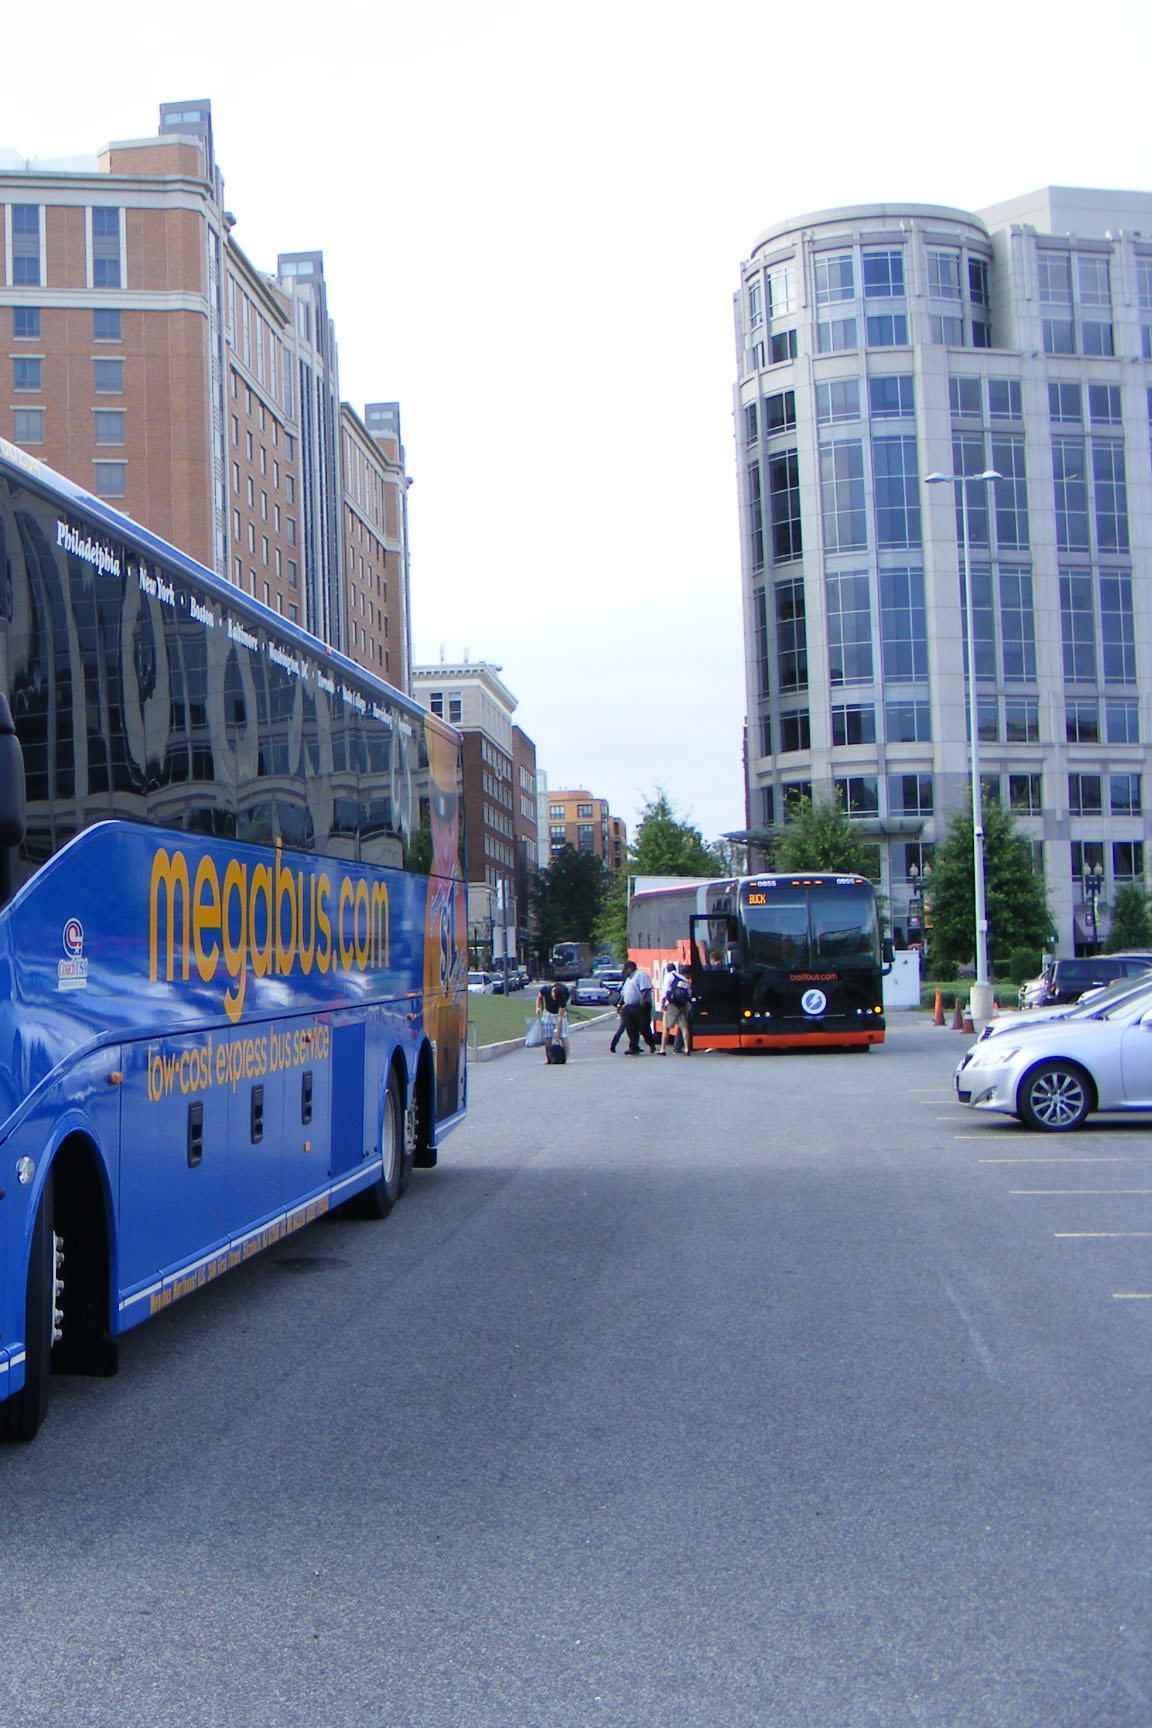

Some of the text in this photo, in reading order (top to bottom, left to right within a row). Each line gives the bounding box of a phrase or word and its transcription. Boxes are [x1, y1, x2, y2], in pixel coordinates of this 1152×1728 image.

[57, 520, 120, 577] Philadelphia
[139, 566, 156, 596] New
[156, 575, 175, 607] York
[190, 595, 214, 629] Boston
[149, 837, 390, 1023] megabus.com
[749, 893, 766, 904] BUCK
[147, 1017, 330, 1103] low-cost express bus service
